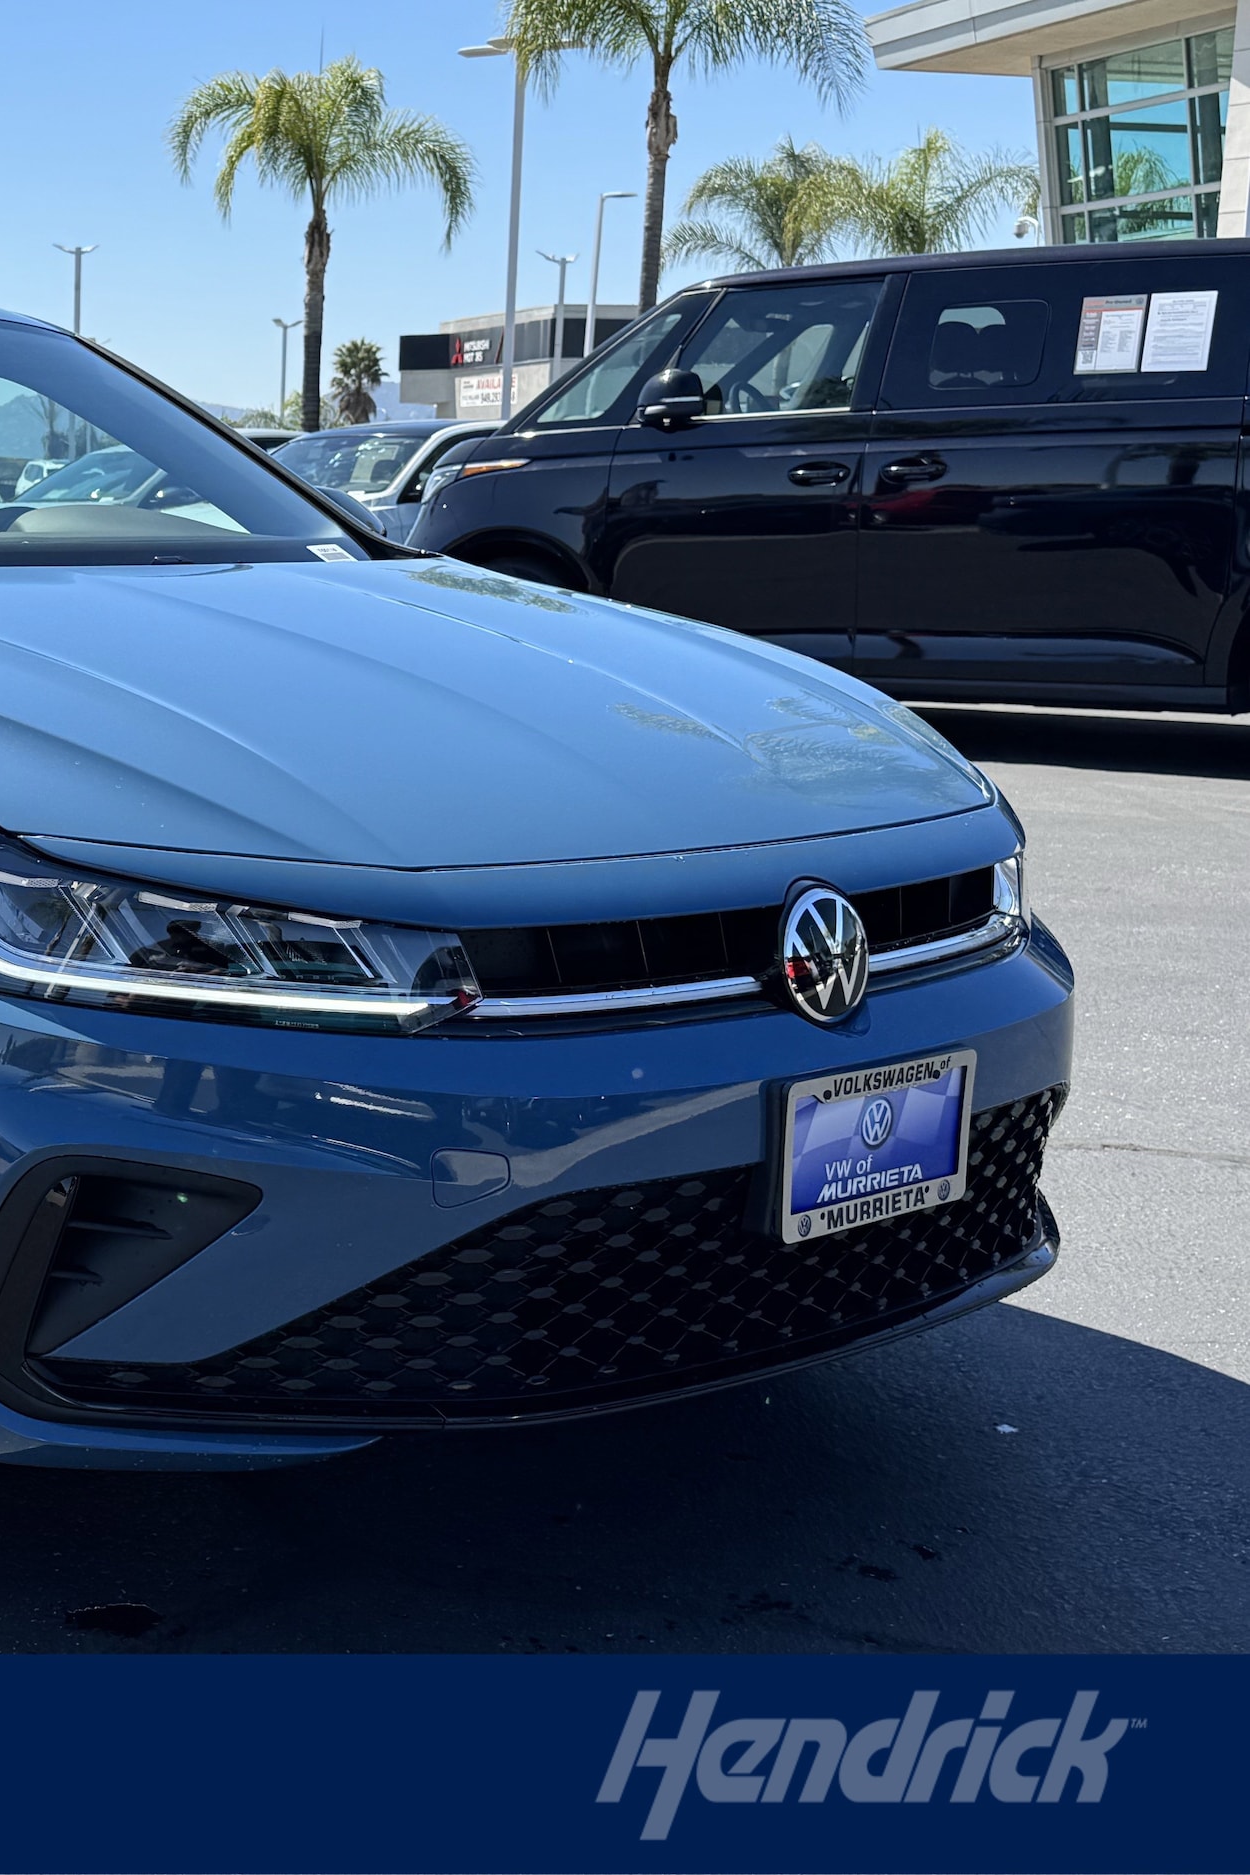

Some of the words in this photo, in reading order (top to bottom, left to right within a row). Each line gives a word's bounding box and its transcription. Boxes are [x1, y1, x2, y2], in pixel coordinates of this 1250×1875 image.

[833, 1061, 934, 1097] VOLKSWAGEN
[940, 1056, 951, 1070] of
[816, 1163, 924, 1204] MURRIETA
[825, 1159, 852, 1181] VW
[856, 1154, 873, 1175] of
[826, 1188, 925, 1230] MURRIETA
